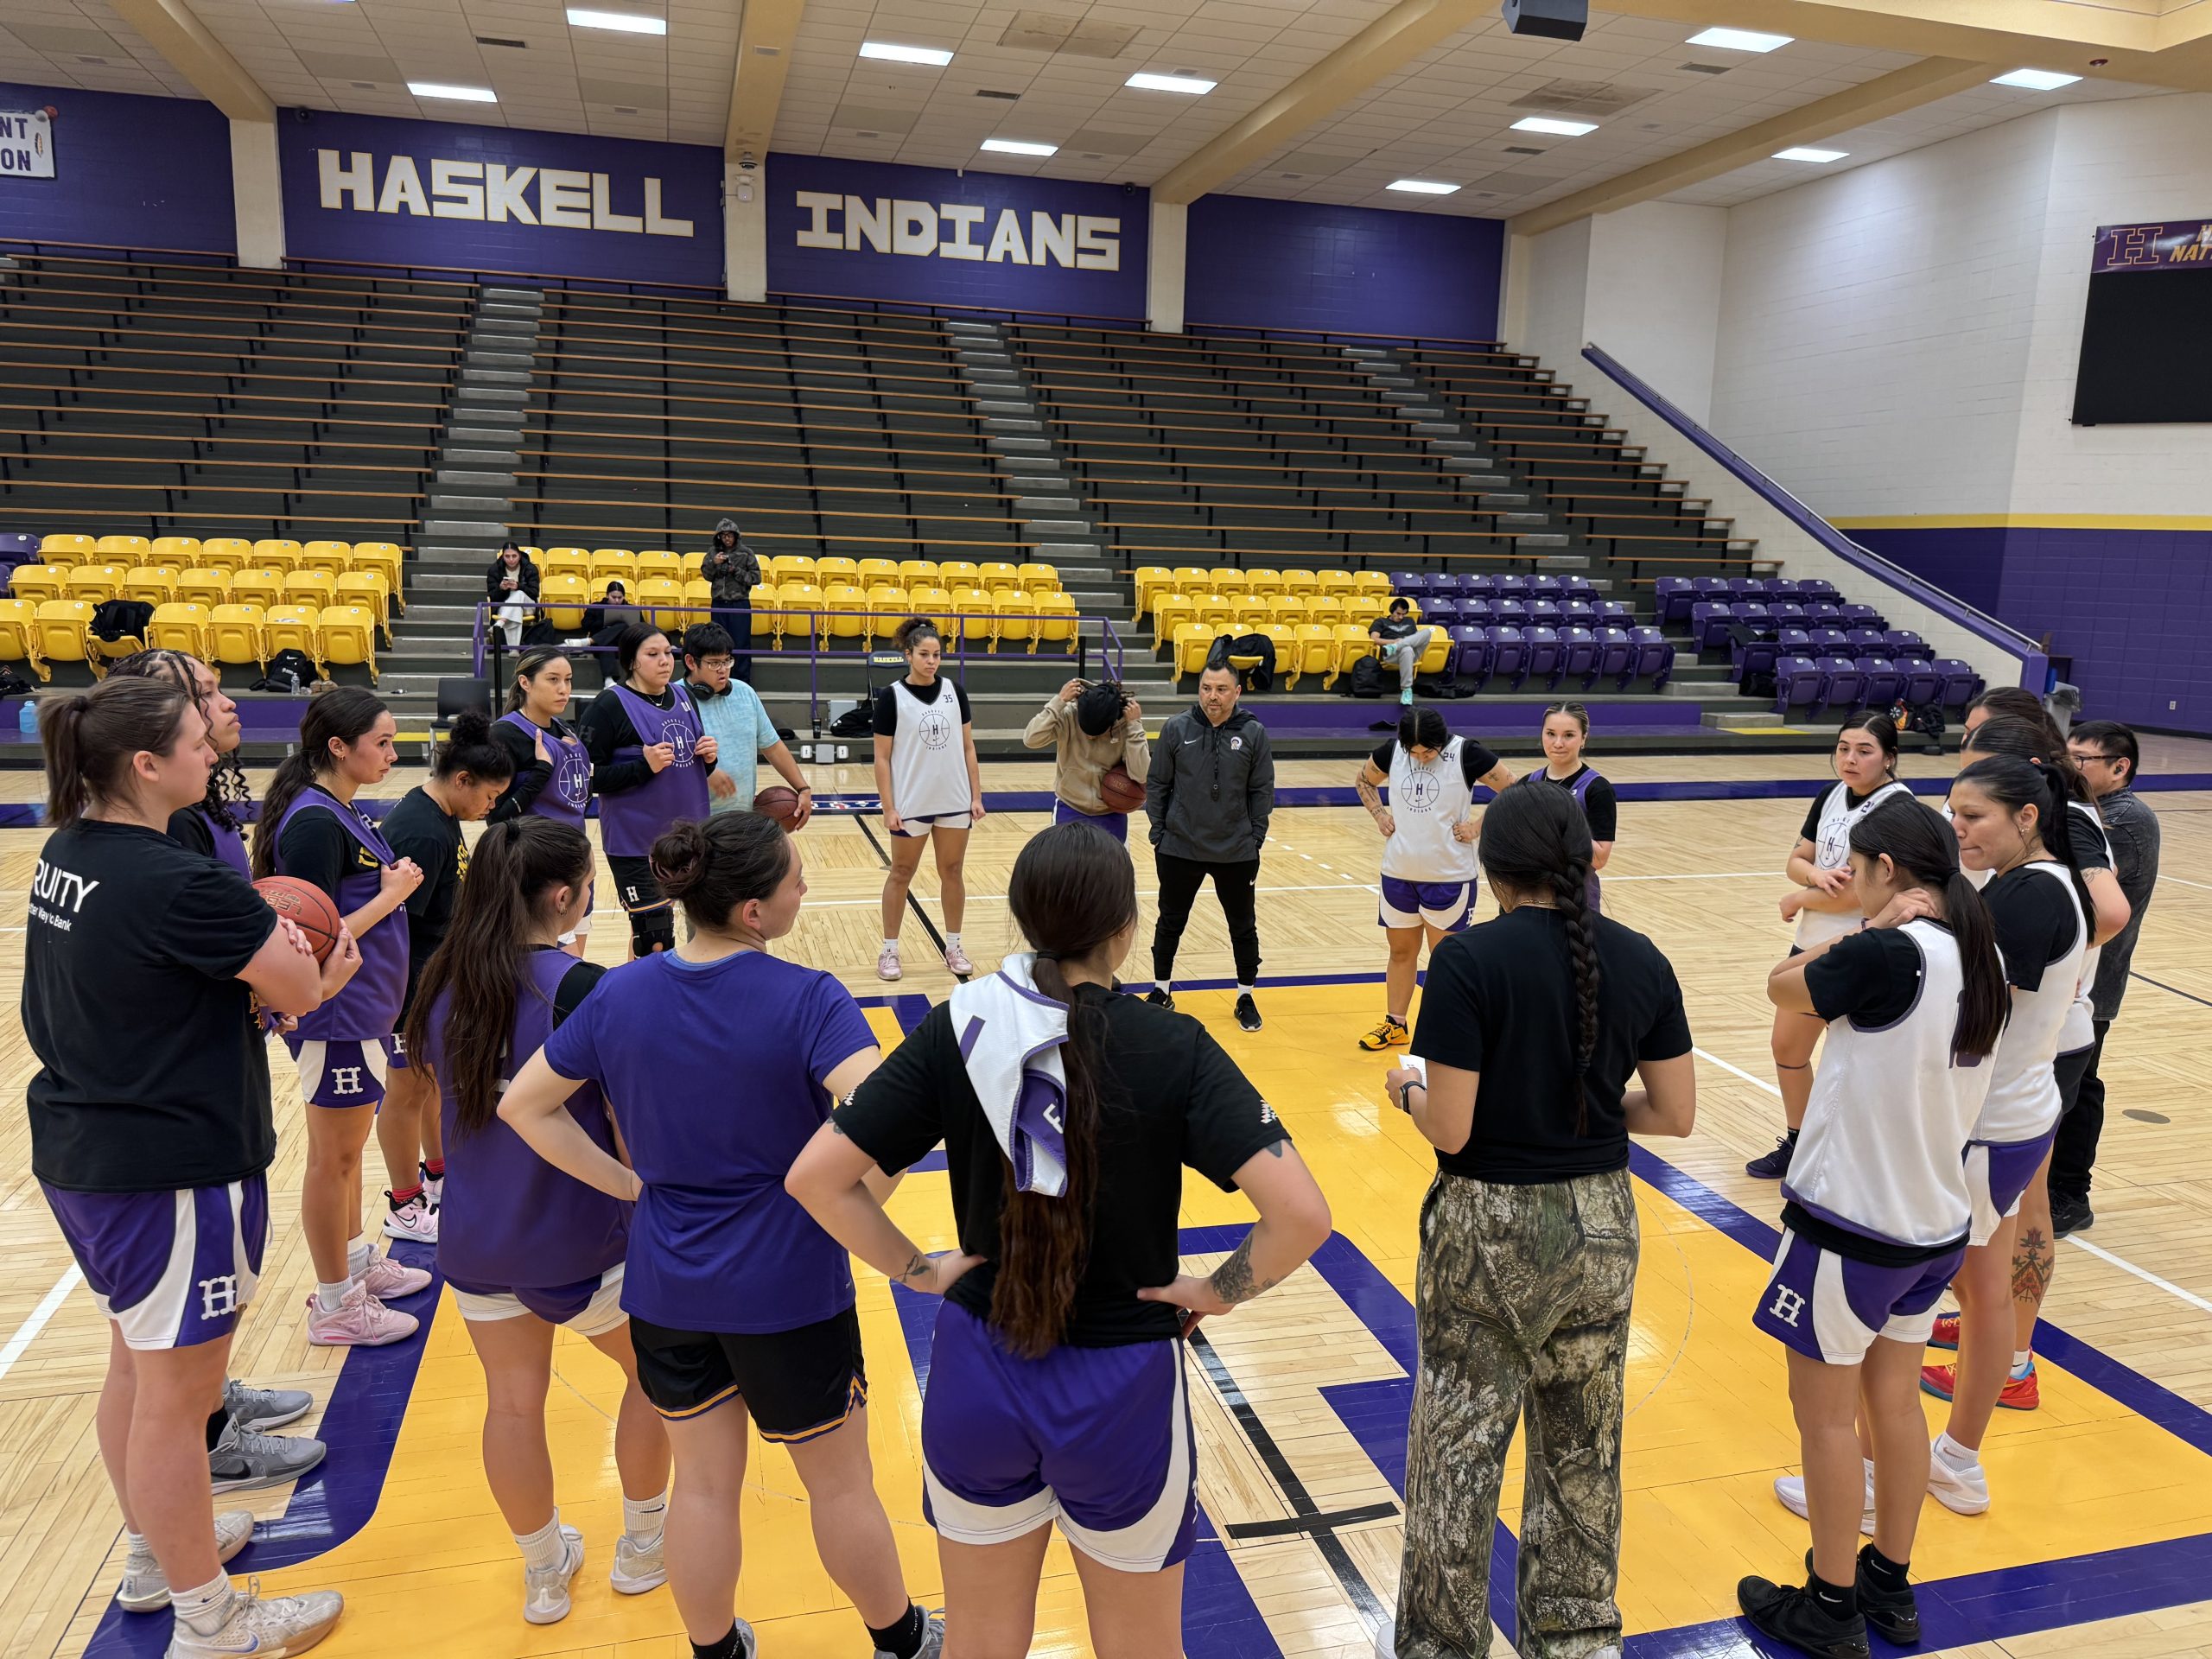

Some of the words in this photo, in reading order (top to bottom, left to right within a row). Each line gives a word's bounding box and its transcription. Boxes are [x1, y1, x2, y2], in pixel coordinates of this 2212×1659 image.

[317, 148, 695, 238] HASKELL
[796, 190, 1121, 272] INDIANS
[2107, 226, 2164, 266] H
[944, 694, 953, 703] 35
[932, 724, 939, 735] H
[676, 735, 684, 750] H
[1443, 752, 1455, 762] 24
[573, 773, 583, 789] H
[1415, 783, 1424, 796] H
[1827, 836, 1835, 852] H
[626, 886, 640, 903] H
[54, 914, 73, 931] Bank
[331, 1066, 364, 1095] H
[198, 1274, 237, 1320] H
[1769, 1283, 1806, 1328] H
